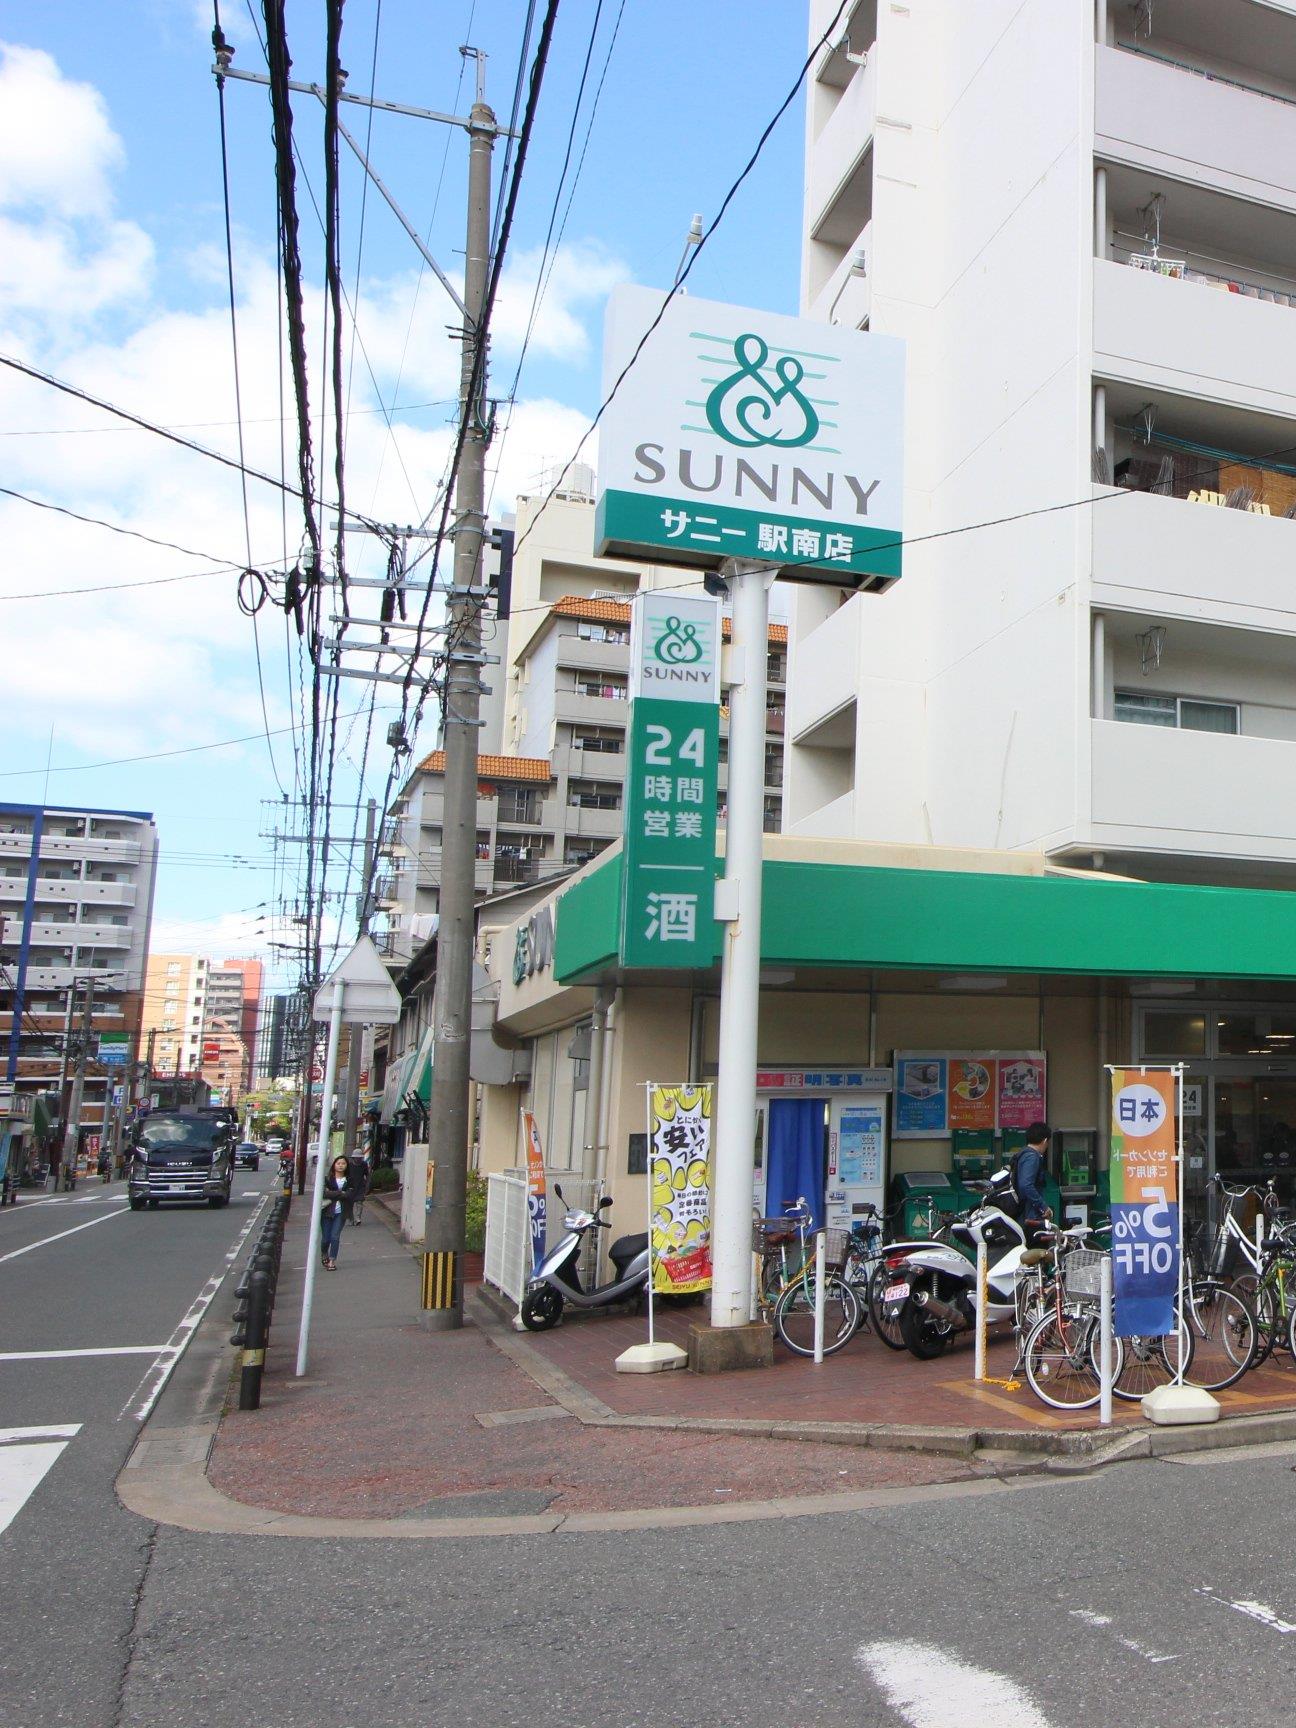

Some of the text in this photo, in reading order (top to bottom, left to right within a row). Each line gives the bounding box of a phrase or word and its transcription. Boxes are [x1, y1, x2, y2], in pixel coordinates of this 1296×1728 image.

[633, 443, 881, 515] SUNNY
[660, 509, 854, 563] サニー 駅南店
[643, 665, 712, 684] SUNNY
[645, 725, 705, 767] 24
[644, 891, 698, 942] 酒
